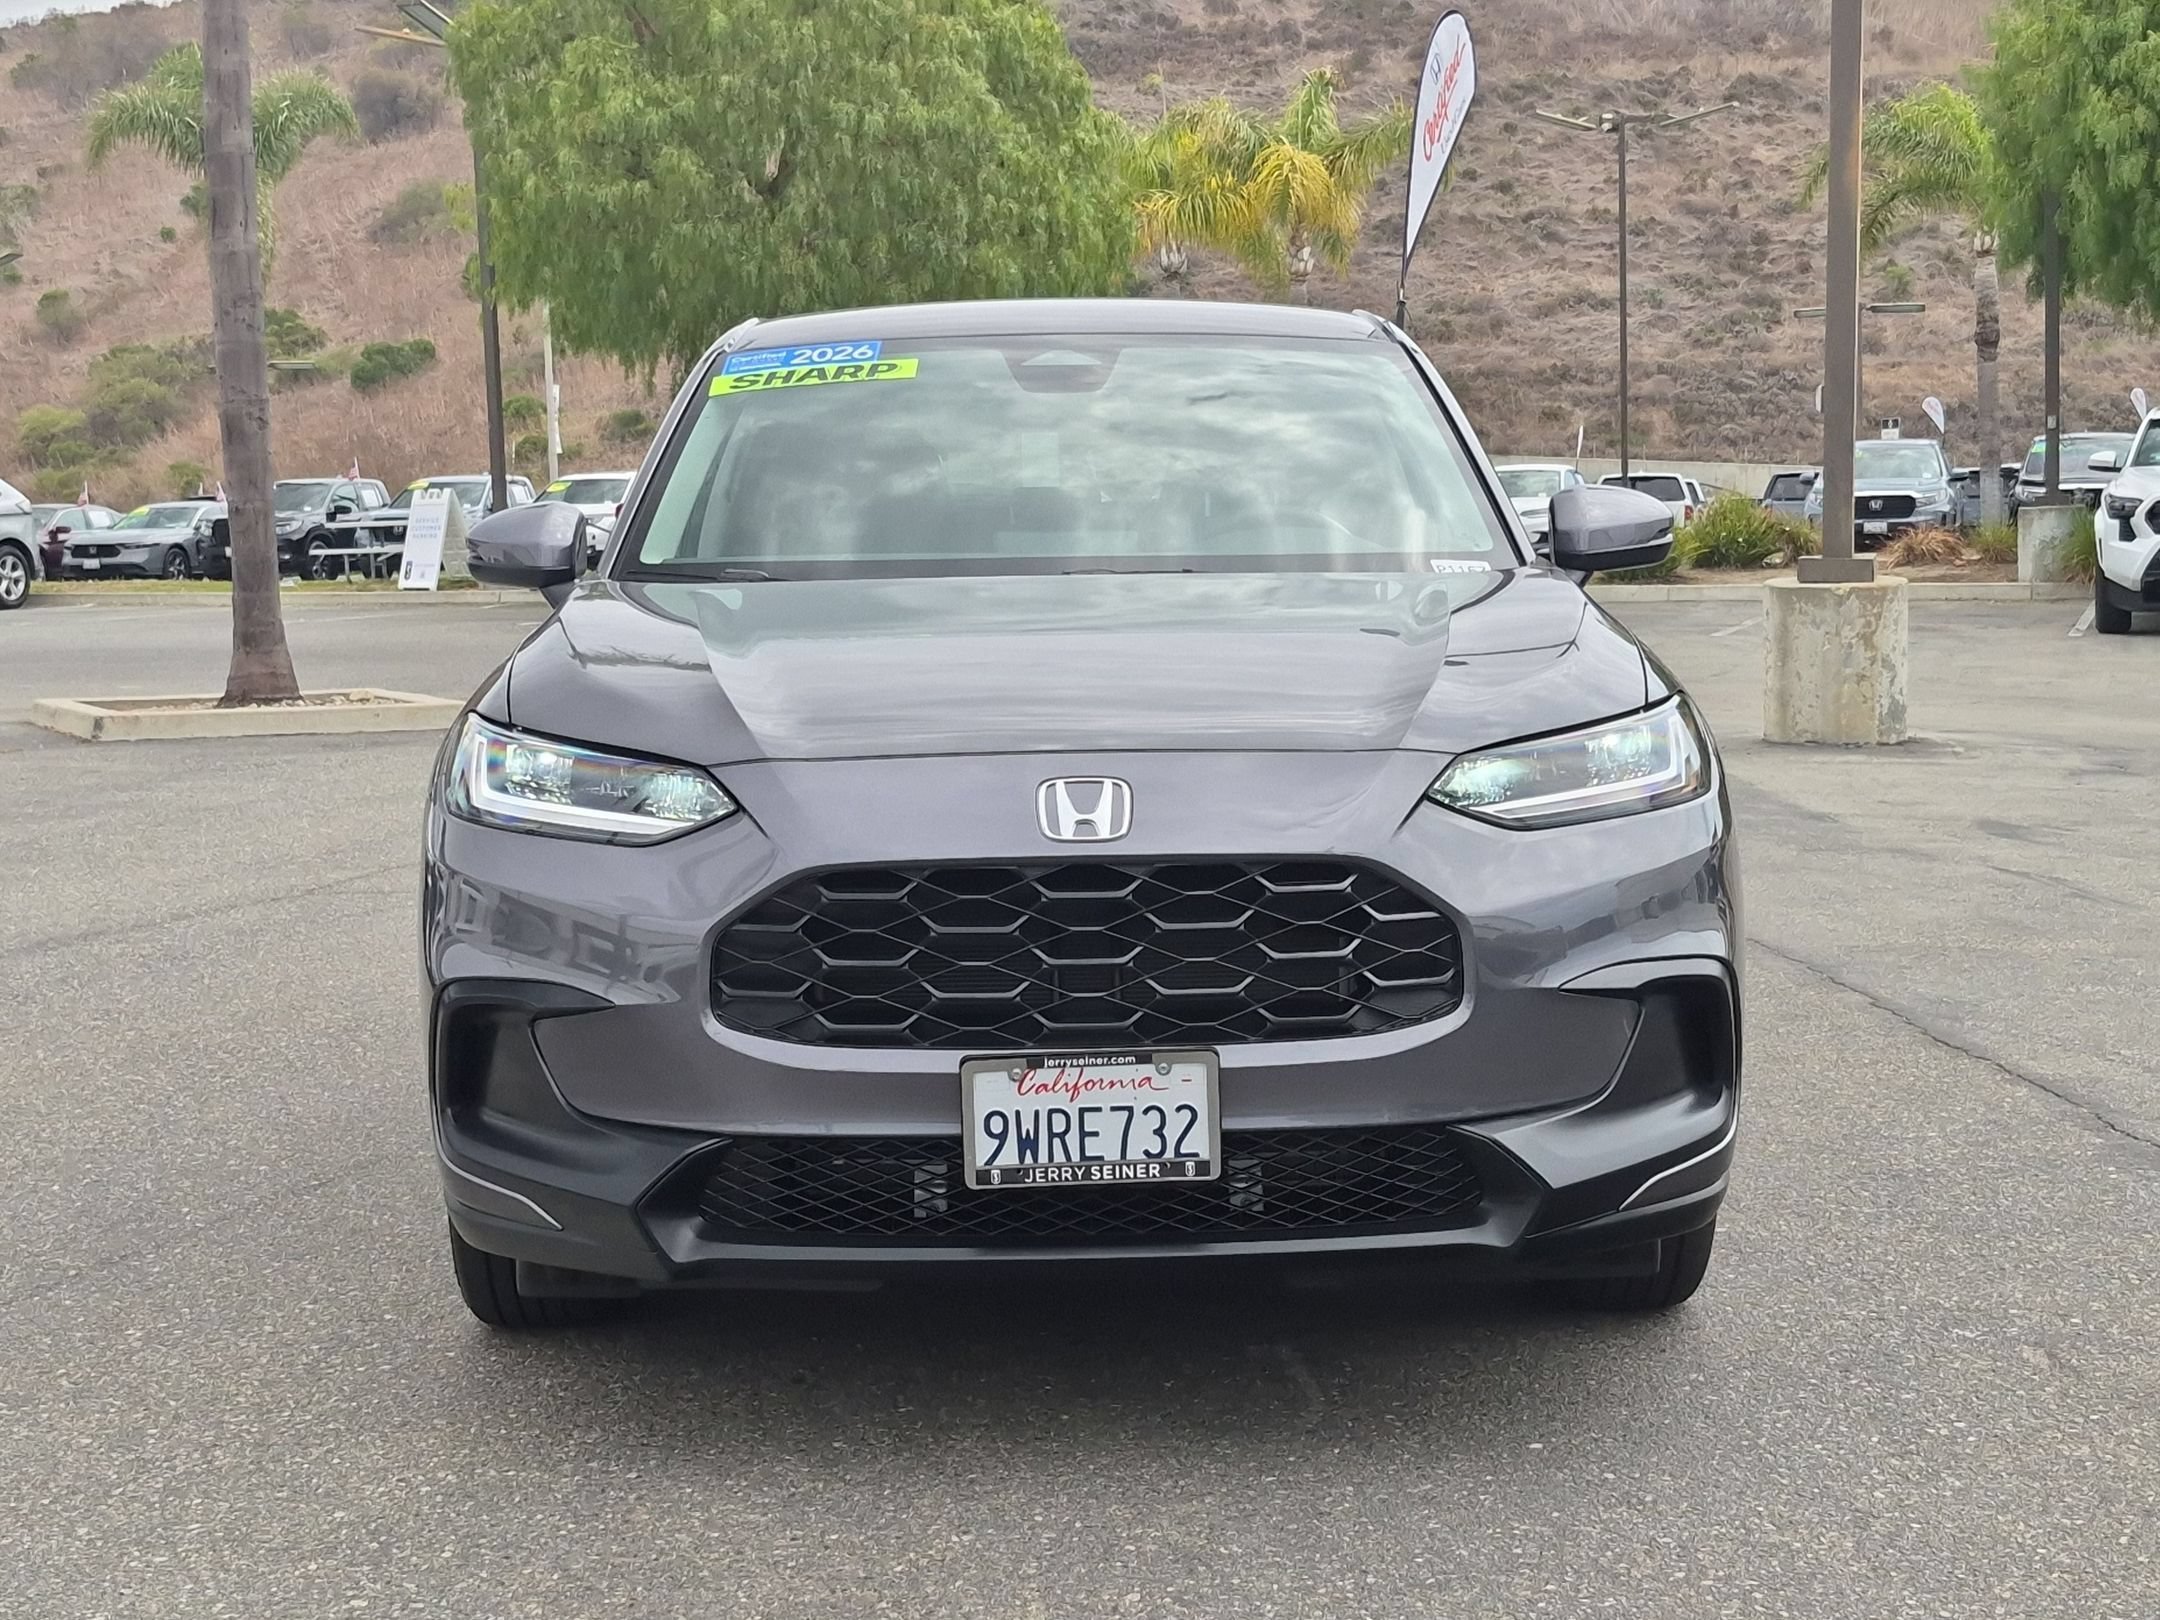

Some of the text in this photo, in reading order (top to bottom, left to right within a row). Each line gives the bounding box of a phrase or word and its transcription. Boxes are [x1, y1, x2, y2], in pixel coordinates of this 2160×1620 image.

[791, 345, 873, 364] 2026
[729, 363, 898, 389] SHARP
[1043, 1055, 1136, 1068] jerryseiner.com
[1016, 1067, 1169, 1103] California
[983, 1103, 1200, 1166] 9WRE732
[1024, 1163, 1161, 1183] JERRY SEINER
